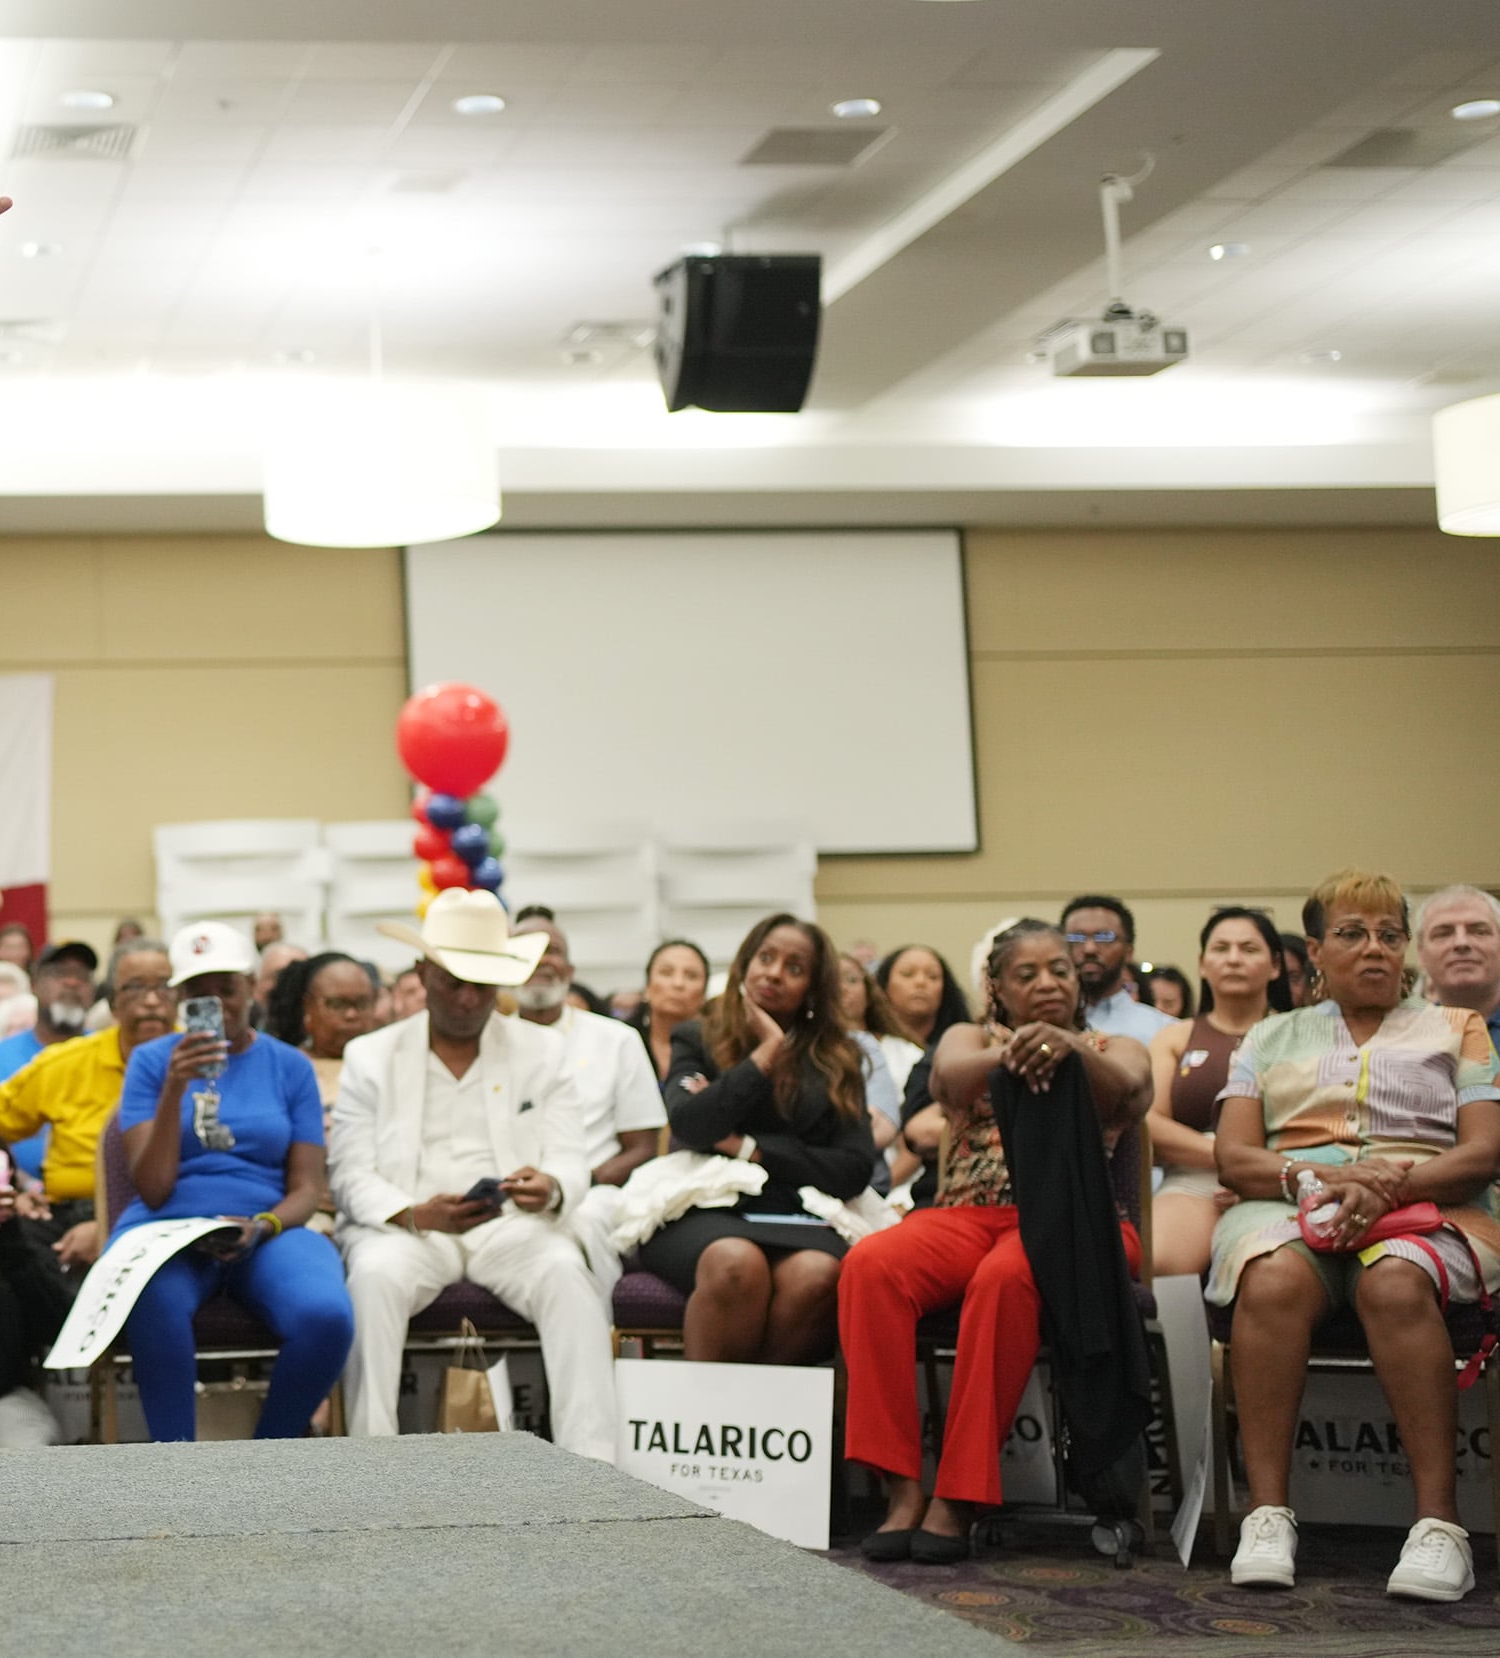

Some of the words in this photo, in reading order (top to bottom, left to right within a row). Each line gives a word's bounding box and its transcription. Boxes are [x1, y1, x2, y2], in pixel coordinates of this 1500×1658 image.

[628, 1420, 813, 1463] TALARICO
[670, 1463, 701, 1479] FOR
[708, 1466, 764, 1483] TEXAS
[1329, 1460, 1367, 1474] FOR
